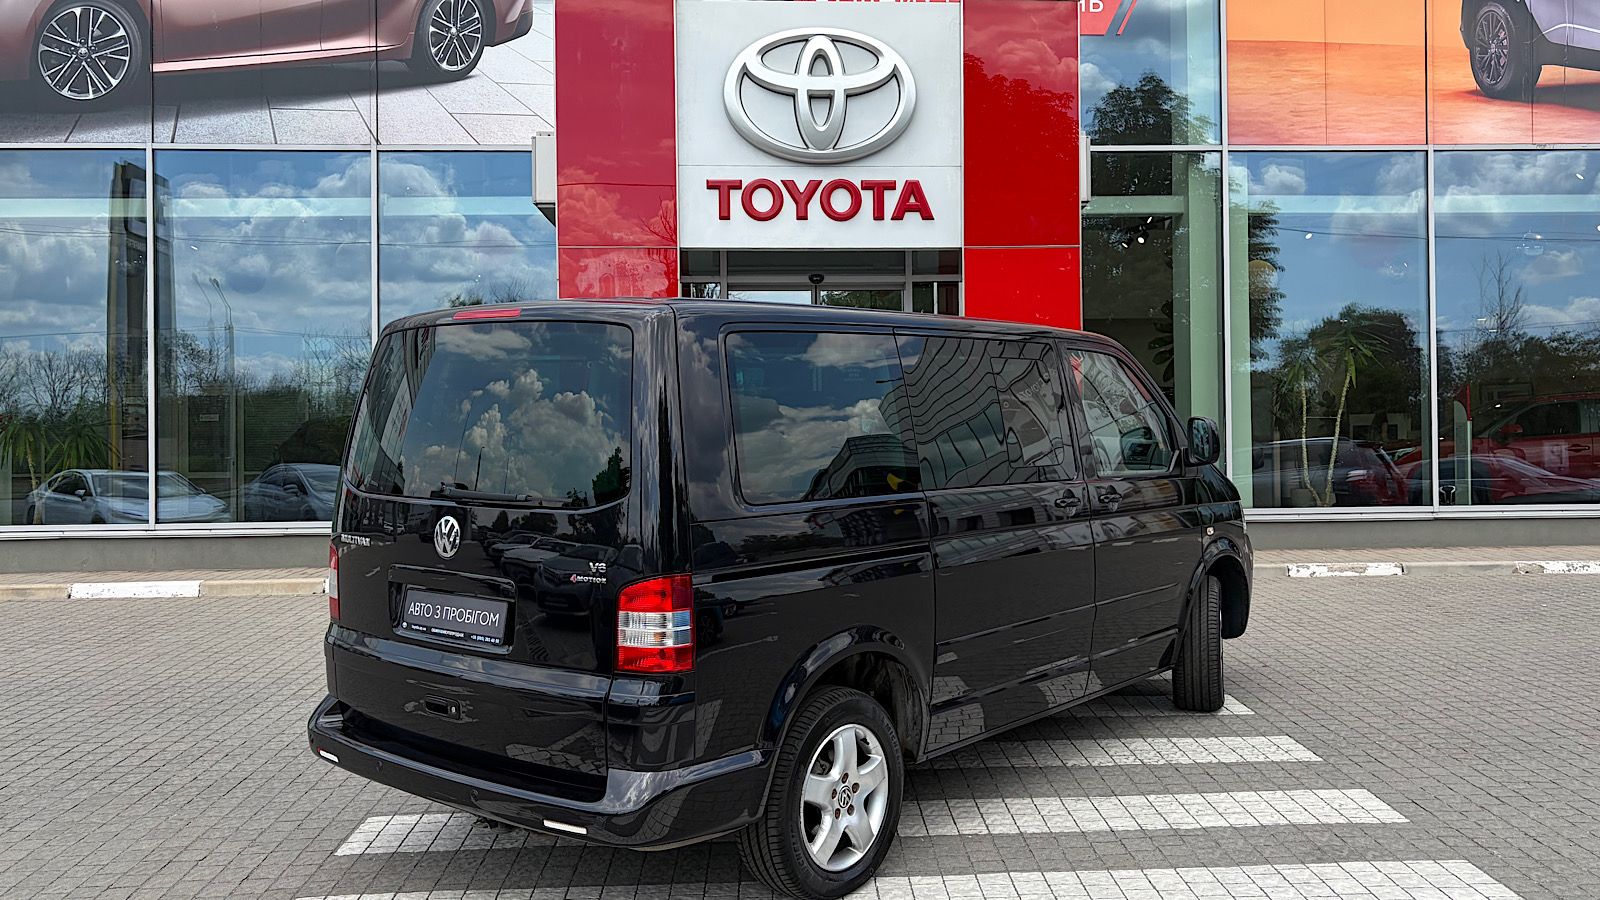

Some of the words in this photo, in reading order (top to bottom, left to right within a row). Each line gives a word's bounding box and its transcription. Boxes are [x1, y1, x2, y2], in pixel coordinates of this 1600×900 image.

[706, 178, 935, 222] TOYOTA
[408, 602, 432, 617] АВТО
[442, 607, 499, 627] ПРОБІГОМ
